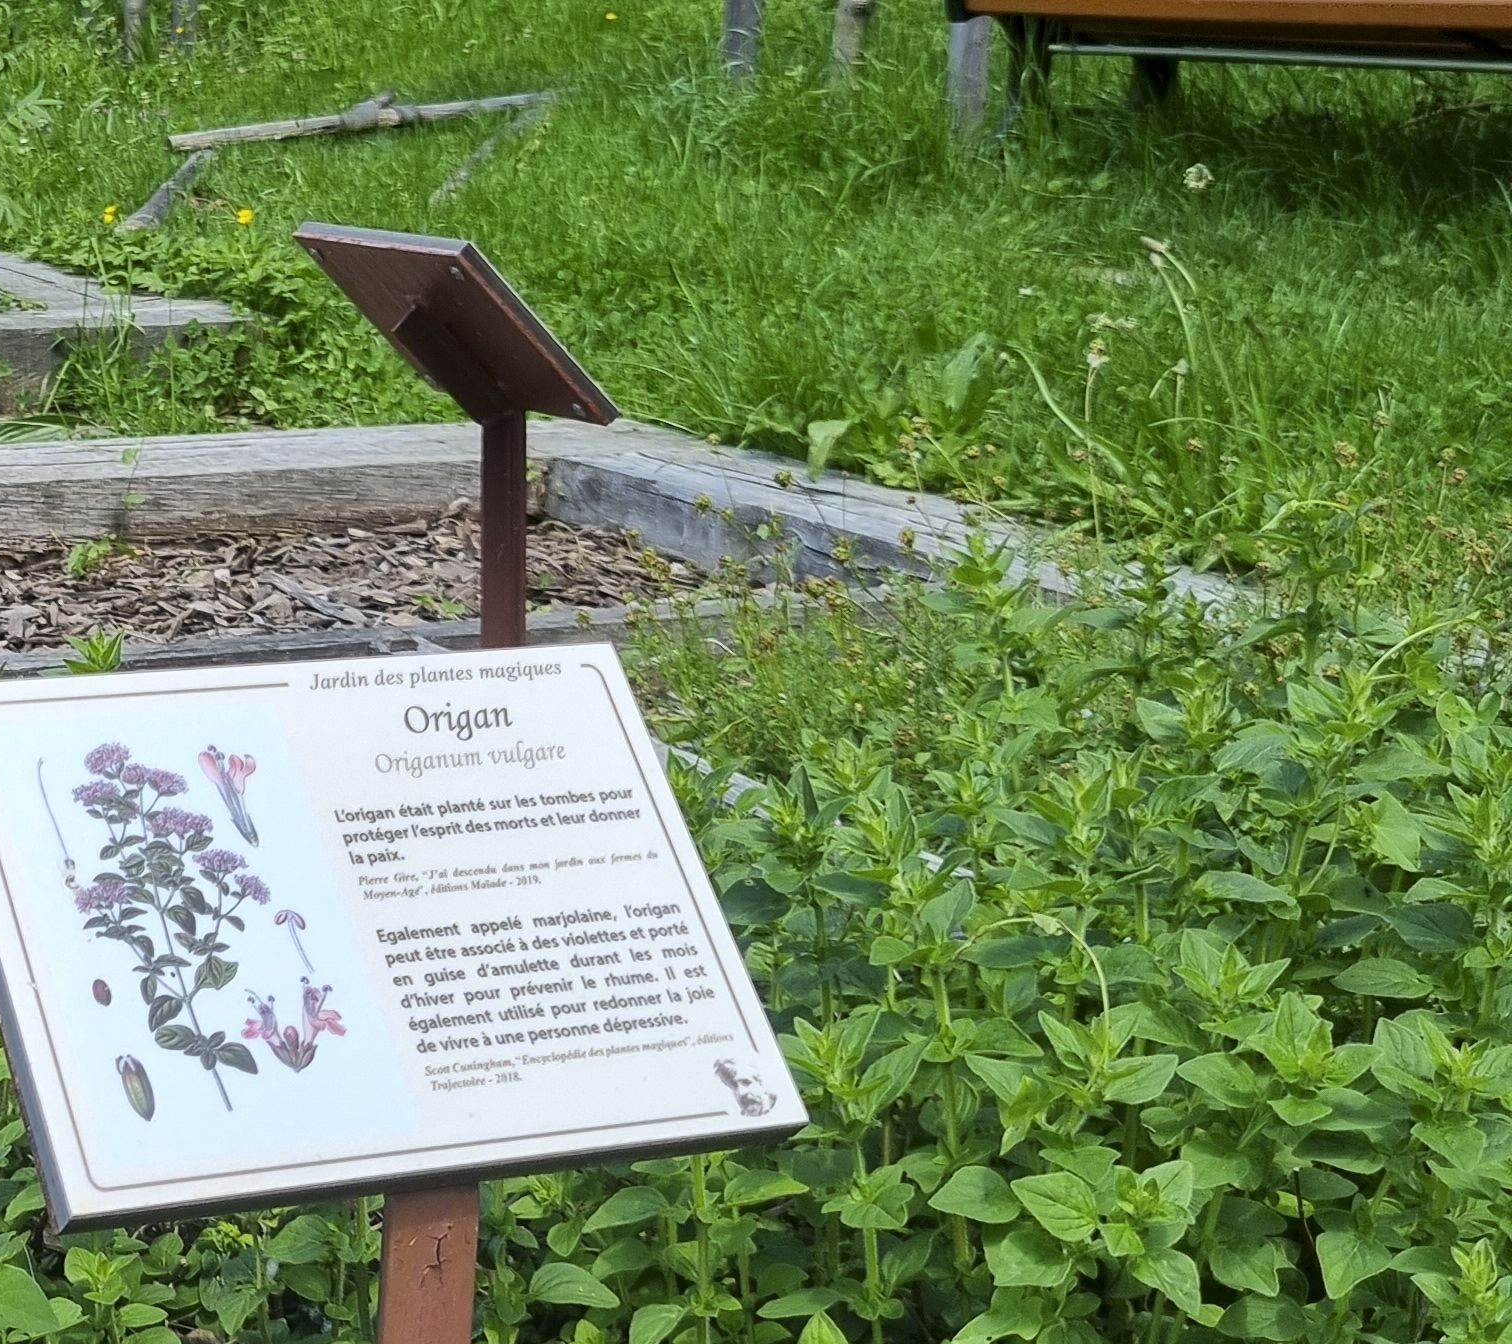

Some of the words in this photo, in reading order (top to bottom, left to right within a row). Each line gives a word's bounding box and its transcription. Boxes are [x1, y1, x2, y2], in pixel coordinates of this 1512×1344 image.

[309, 672, 368, 691] Jardin
[375, 670, 403, 685] des
[410, 667, 473, 688] plantes
[480, 662, 561, 683] magiques
[403, 702, 512, 741] Origan
[375, 752, 482, 778] Origanum
[488, 741, 566, 770] vulgare
[399, 801, 433, 818] était
[437, 798, 485, 817] planté
[489, 797, 511, 810] sur
[515, 795, 536, 808] les
[540, 790, 595, 806] tombes
[599, 788, 632, 806] pour
[343, 825, 409, 847] protéger
[466, 819, 491, 834] des
[494, 816, 537, 831] morts
[540, 814, 555, 827] et
[557, 811, 585, 826] leur
[589, 808, 641, 822] donner
[349, 851, 364, 865] la
[369, 848, 405, 866] paix.
[359, 874, 389, 886] Pierre
[453, 866, 496, 878] descendu
[502, 862, 525, 873] dans
[530, 862, 549, 870] mon
[555, 858, 583, 869] jardin
[588, 857, 606, 865] aux
[610, 852, 641, 864] fermes
[647, 850, 658, 859] du
[430, 881, 468, 894] éditions
[516, 876, 541, 886] 2019.
[376, 923, 459, 946] Egalement
[471, 916, 523, 938] appelé
[532, 909, 617, 929] marjolaine,
[385, 948, 422, 968] peut
[425, 944, 459, 961] être
[461, 941, 516, 957] associé
[519, 936, 529, 951] à
[532, 935, 559, 950] des
[562, 928, 626, 946] violettes
[630, 927, 645, 941] et
[649, 921, 689, 942] porté
[393, 974, 413, 987] en
[424, 968, 466, 987] guise
[570, 952, 621, 968] durant
[630, 947, 652, 963] les
[662, 944, 698, 960] mois
[464, 987, 500, 1006] pour
[510, 978, 573, 1000] prévenir
[582, 976, 596, 989] le
[606, 971, 658, 987] rhume.
[665, 967, 675, 980] Il
[685, 965, 707, 979] est
[408, 1011, 493, 1033] également
[499, 1003, 544, 1022] utilisé
[551, 1002, 587, 1020] pour
[593, 994, 662, 1011] redonner
[668, 989, 682, 1002] la
[687, 986, 715, 1004] joie
[416, 1040, 437, 1054] de
[440, 1034, 480, 1049] vivre
[483, 1030, 492, 1046] à
[495, 1031, 525, 1044] une
[528, 1024, 600, 1043] personne
[603, 1014, 689, 1036] dépressive.
[424, 1064, 449, 1077] Scott
[588, 1047, 605, 1058] des
[606, 1042, 641, 1058] plantes
[696, 1032, 733, 1046] éditions
[431, 1076, 486, 1092] Trajectoire
[496, 1071, 522, 1084] 2018.
